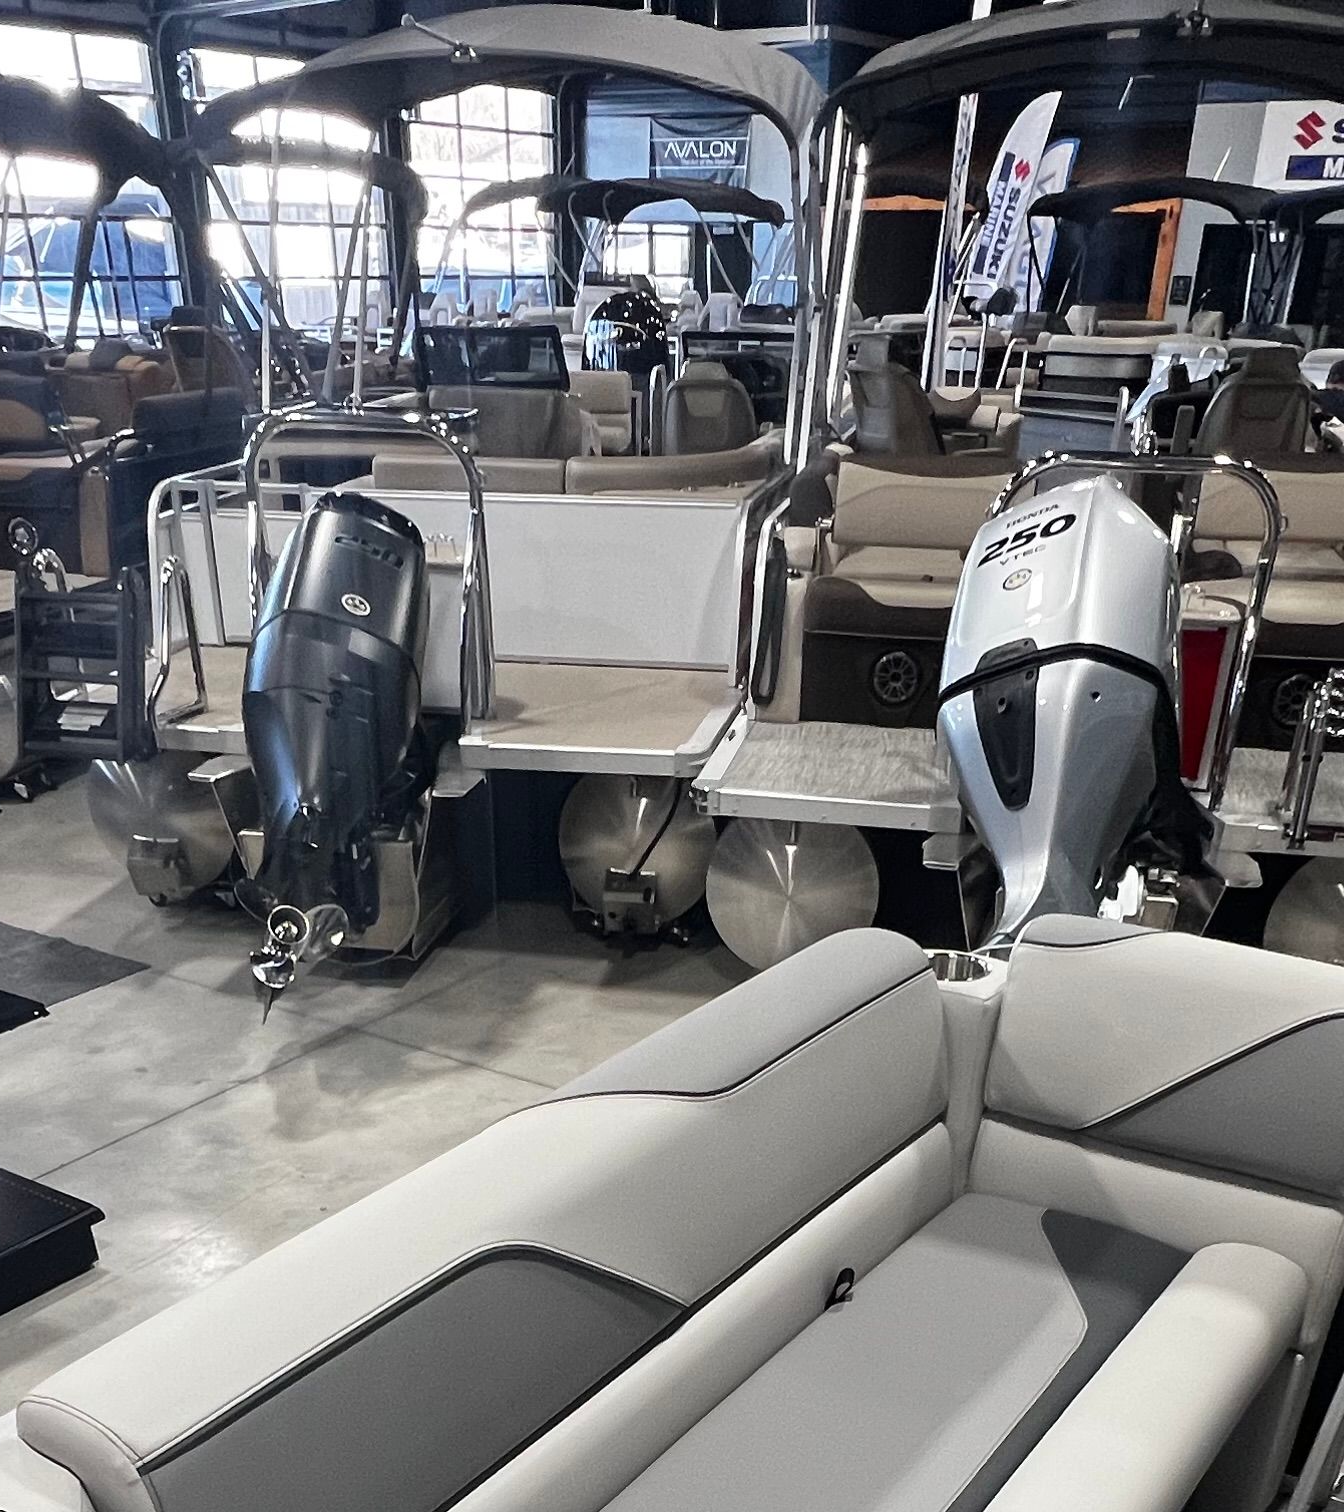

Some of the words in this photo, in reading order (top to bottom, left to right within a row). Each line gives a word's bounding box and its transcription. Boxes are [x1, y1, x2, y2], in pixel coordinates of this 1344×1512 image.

[664, 140, 737, 158] AVALON
[980, 180, 1008, 247] MARINE
[986, 187, 1022, 279] SUZUKI
[977, 514, 1076, 568] 250
[999, 544, 1046, 566] VTEC
